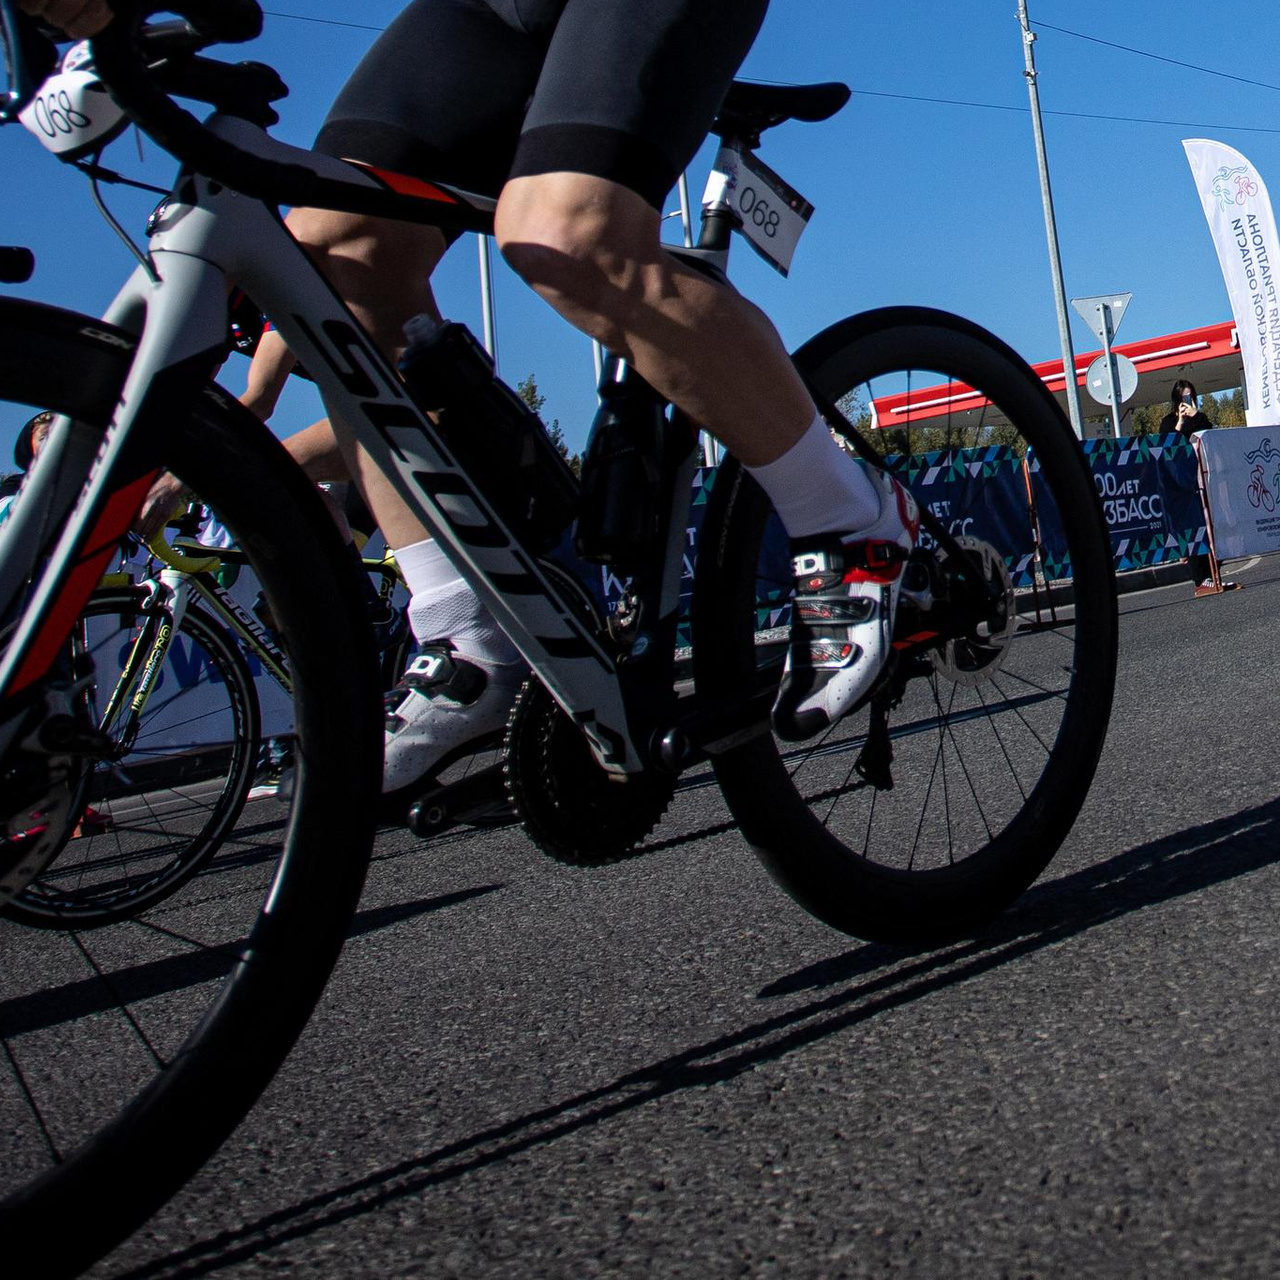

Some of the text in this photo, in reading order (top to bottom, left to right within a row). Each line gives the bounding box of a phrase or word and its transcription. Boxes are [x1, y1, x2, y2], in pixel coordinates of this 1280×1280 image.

[34, 89, 92, 138] 068
[739, 186, 780, 239] 068
[293, 311, 618, 677] SCOTT
[1102, 493, 1164, 524] ЗБАСС
[1115, 478, 1140, 496] ЛЕТ
